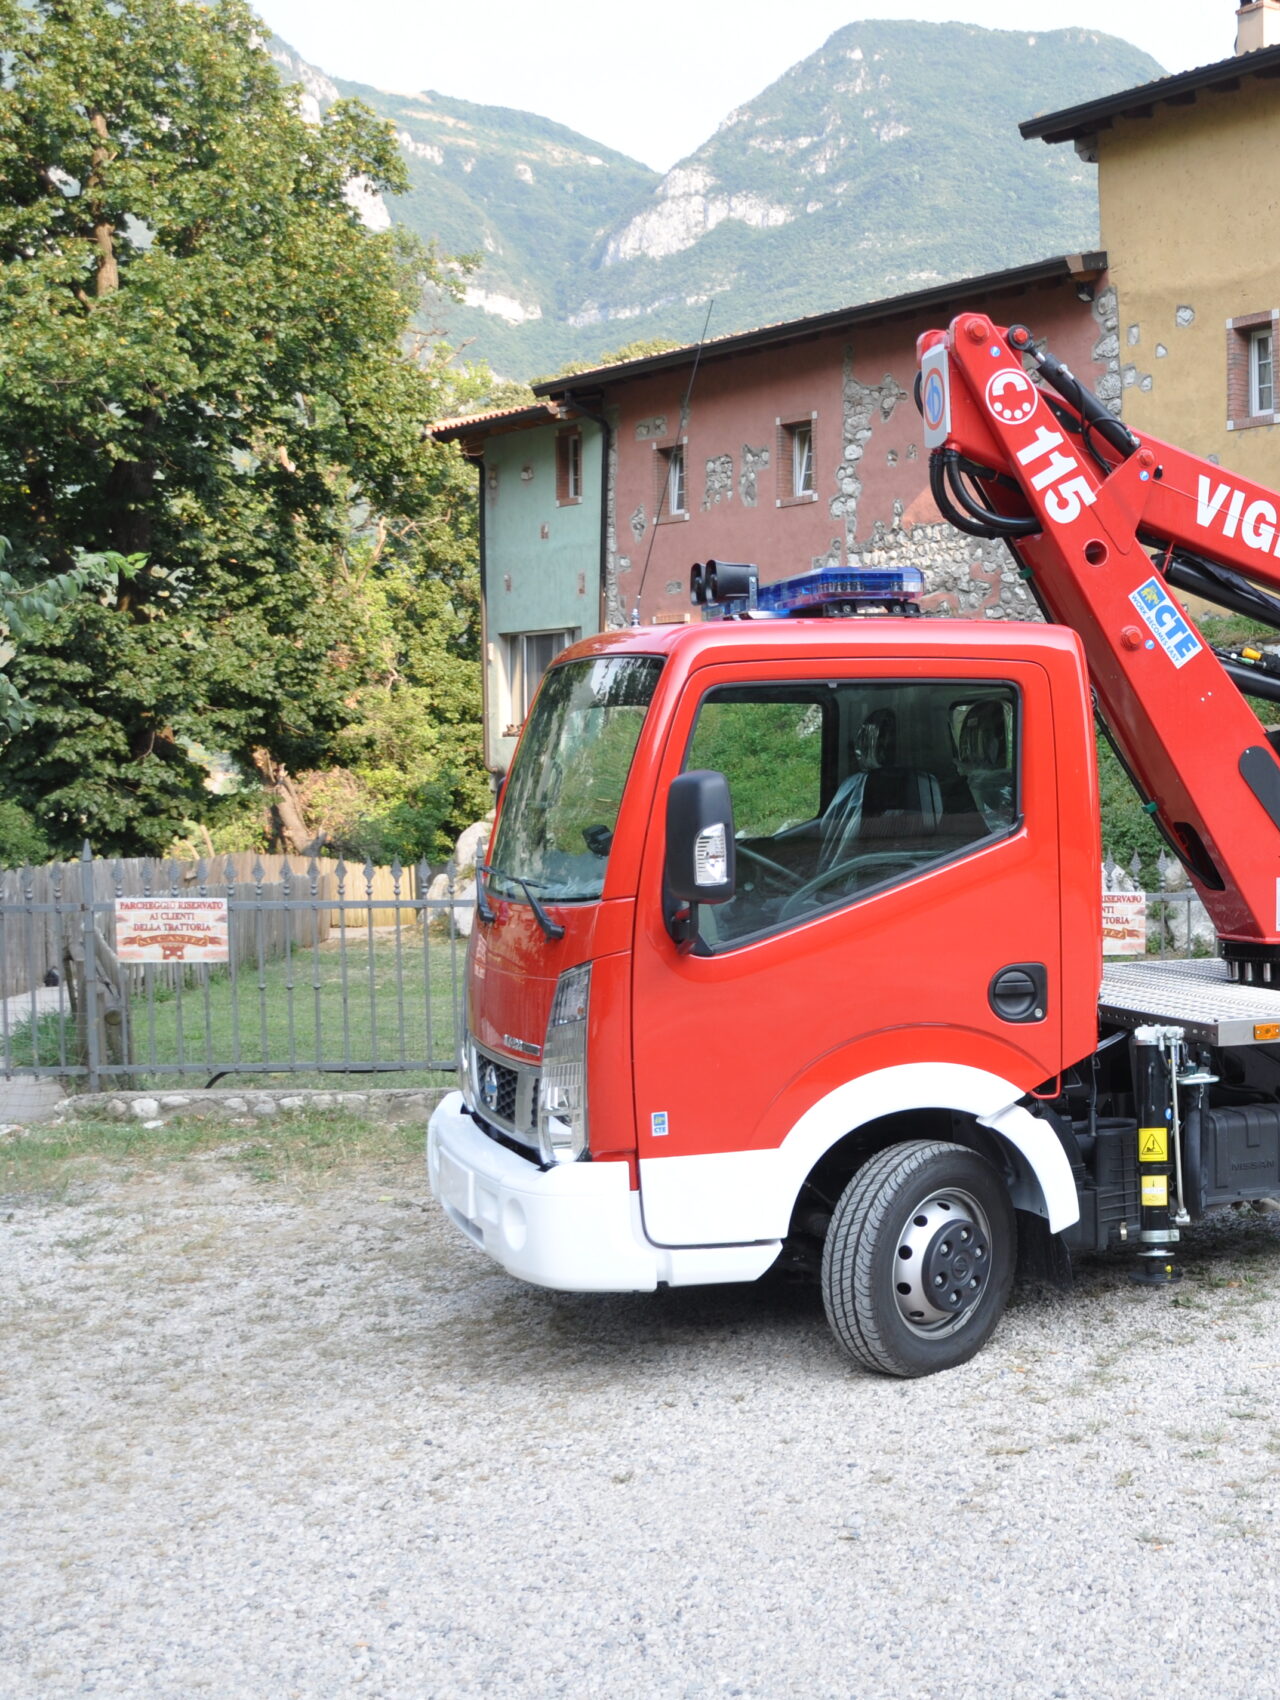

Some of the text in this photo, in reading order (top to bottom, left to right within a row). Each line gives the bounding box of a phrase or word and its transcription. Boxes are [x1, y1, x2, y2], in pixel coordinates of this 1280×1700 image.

[1016, 425, 1097, 524] 115
[1131, 594, 1147, 615] WORK
[1155, 605, 1198, 659] CTE
[1102, 895, 1142, 903] ISERVATO
[120, 901, 223, 910] PARCHEGGIO RISERVATO
[149, 912, 195, 921] AI CLIENTI
[133, 923, 211, 931] DELLA TRATTORIA
[1231, 1160, 1275, 1171] NISSAN
